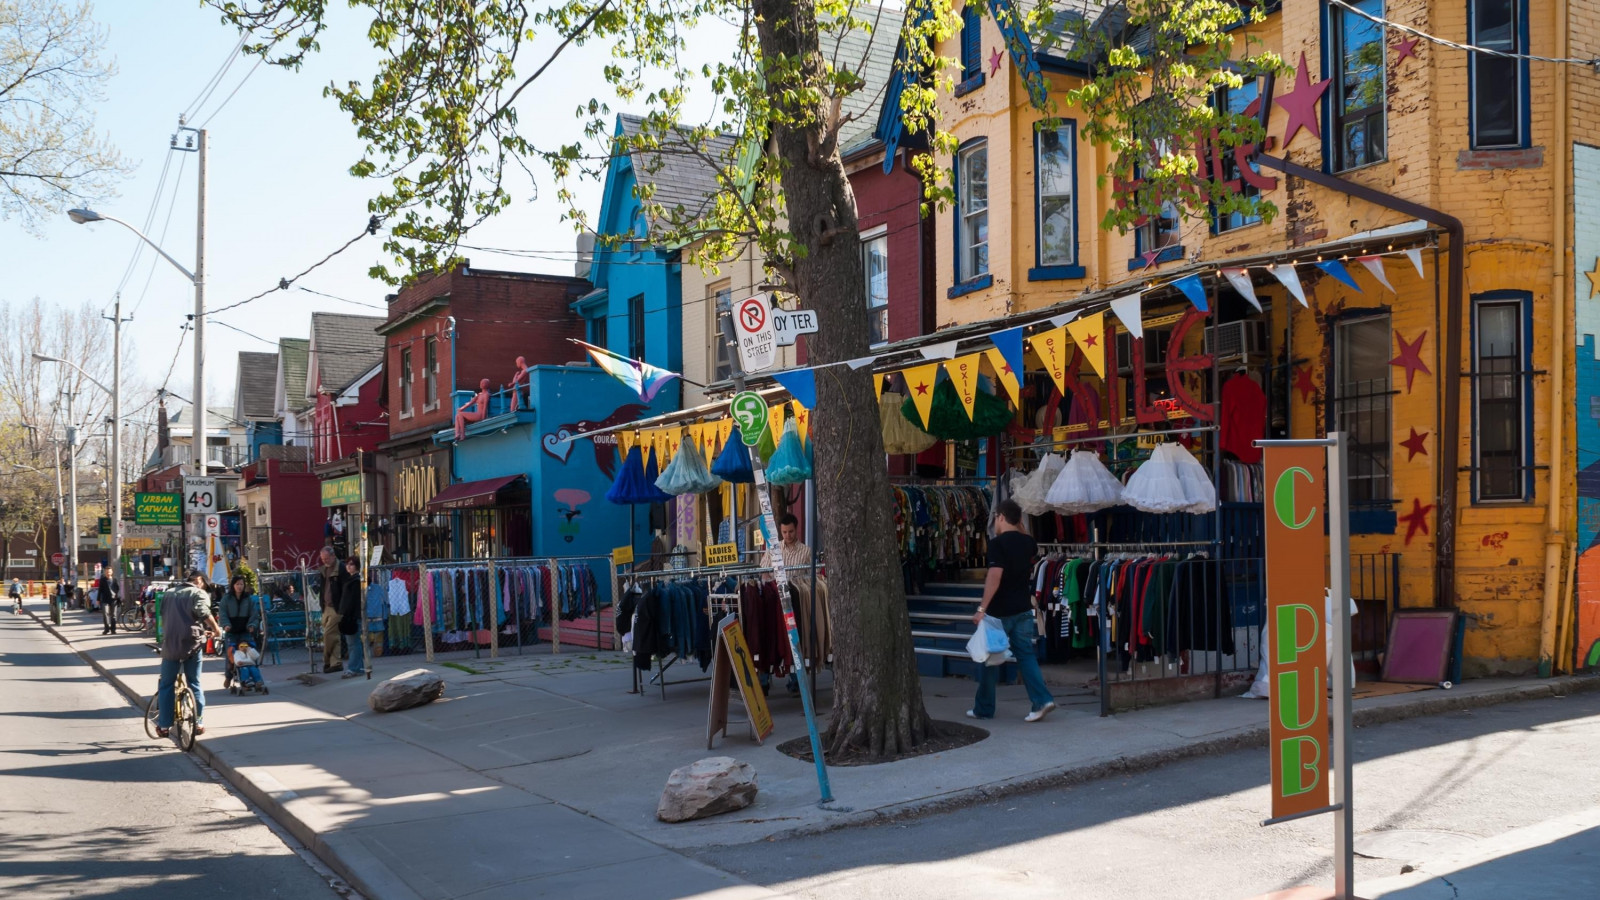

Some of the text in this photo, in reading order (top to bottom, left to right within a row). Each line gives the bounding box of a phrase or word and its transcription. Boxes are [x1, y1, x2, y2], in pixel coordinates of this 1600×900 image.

[791, 314, 815, 330] TER.
[743, 331, 772, 348] ON THIS
[747, 342, 772, 358] STREET
[1140, 434, 1162, 444] POLO
[339, 478, 361, 496] CATWAL
[143, 495, 174, 503] URBAN
[188, 491, 213, 508] 40
[137, 505, 179, 513] CATWALK
[709, 545, 734, 555] LADIES'
[708, 554, 737, 564] BLAZERS
[1274, 466, 1320, 797] C PUB
